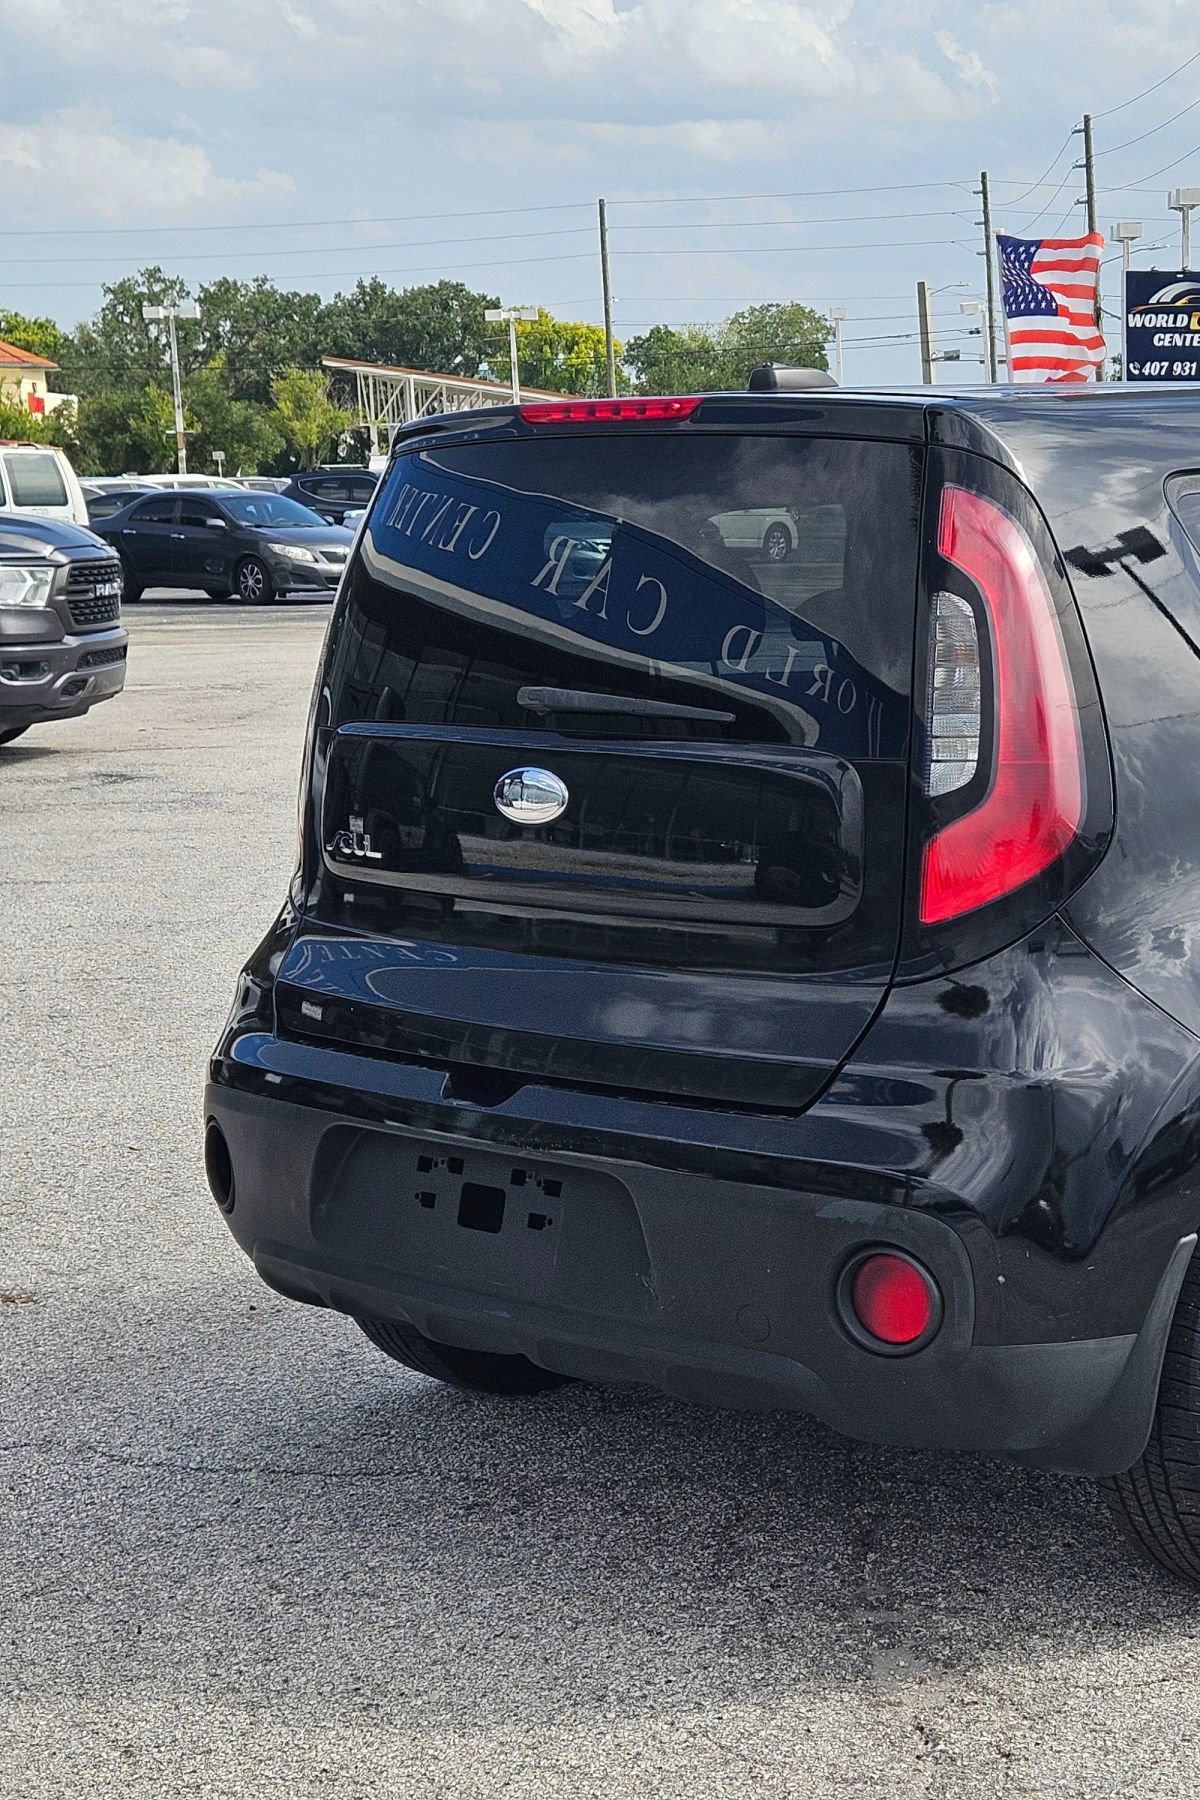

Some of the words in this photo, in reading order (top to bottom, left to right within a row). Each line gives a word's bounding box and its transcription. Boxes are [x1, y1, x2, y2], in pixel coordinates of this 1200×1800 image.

[1128, 313, 1188, 327] WORLD
[1142, 361, 1169, 376] 407
[1172, 361, 1197, 376] 931
